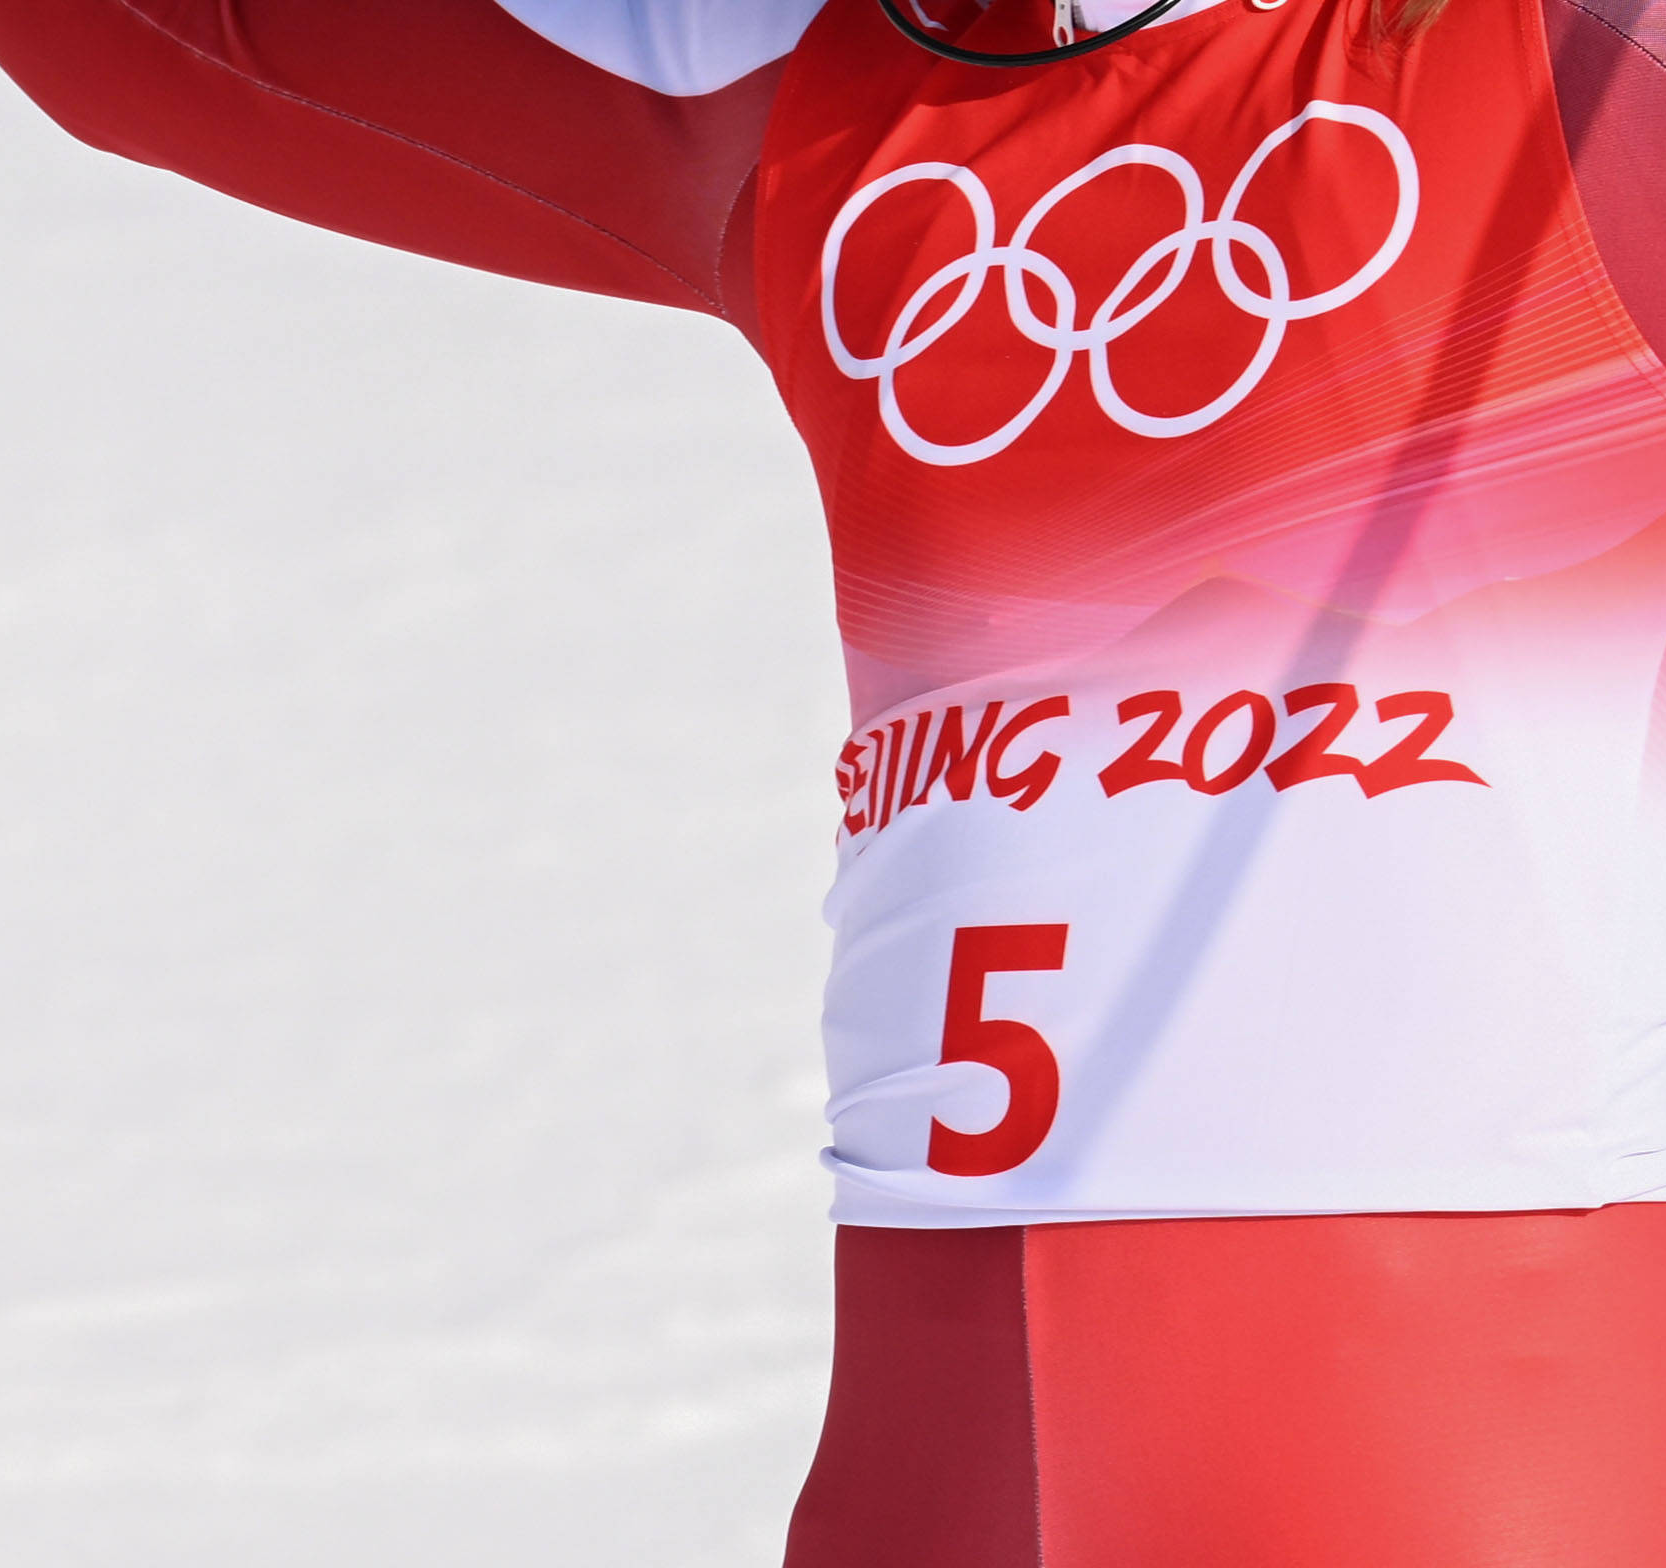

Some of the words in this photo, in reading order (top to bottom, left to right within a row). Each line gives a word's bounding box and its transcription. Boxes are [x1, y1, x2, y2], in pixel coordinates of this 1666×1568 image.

[835, 694, 1071, 845] EIJING
[1097, 683, 1493, 800] 2022
[926, 923, 1069, 1177] 5
